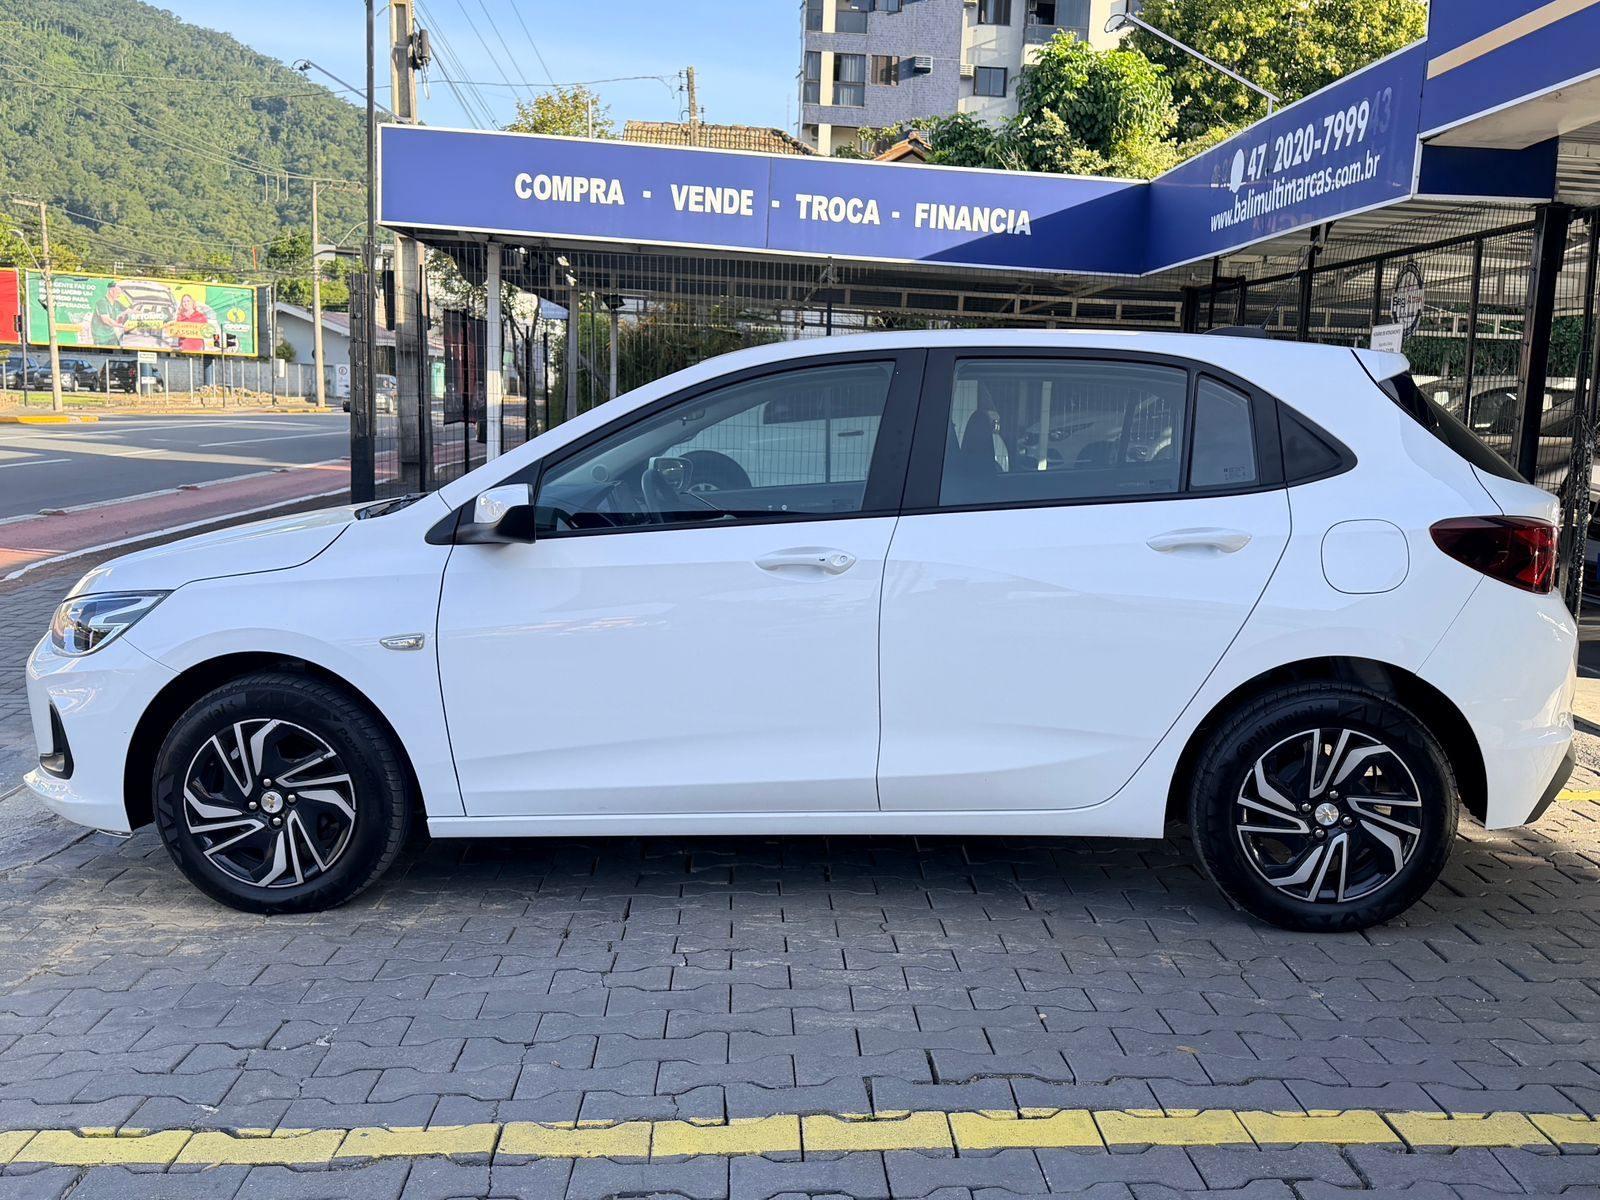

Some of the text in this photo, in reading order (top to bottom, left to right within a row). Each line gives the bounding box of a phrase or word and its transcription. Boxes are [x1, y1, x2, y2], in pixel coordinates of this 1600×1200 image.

[1272, 100, 1371, 173] 2020-7999
[514, 172, 626, 207] COMPRA
[670, 183, 754, 217] VENDE
[795, 193, 881, 226] TROCA
[914, 202, 1032, 236] FINANCIA
[1210, 149, 1381, 233] www.balimultimarcas.com.br
